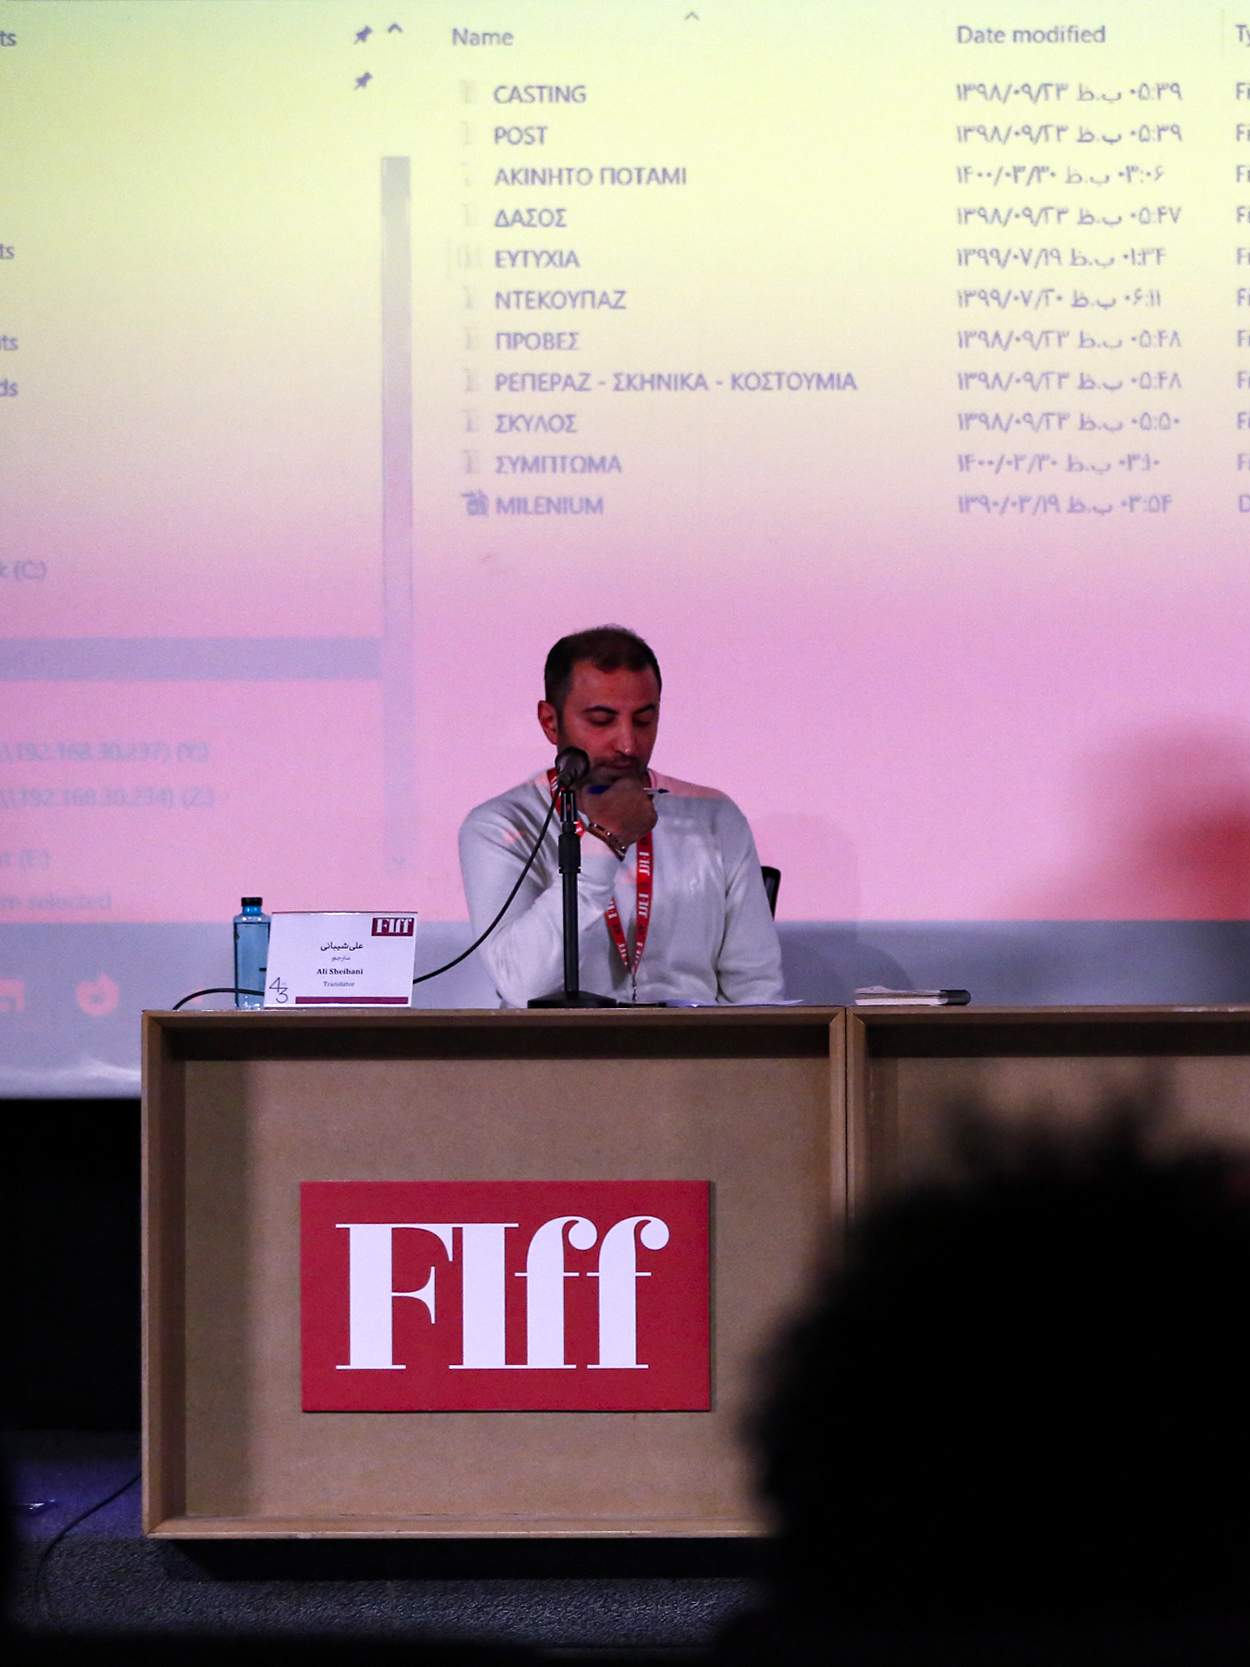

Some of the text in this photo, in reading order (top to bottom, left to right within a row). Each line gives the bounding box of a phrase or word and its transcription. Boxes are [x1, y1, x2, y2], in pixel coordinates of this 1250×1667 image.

[451, 26, 515, 47] Name
[956, 24, 1107, 45] Date modified
[492, 83, 588, 105] CASTING
[492, 124, 549, 147] POST
[494, 166, 688, 187] ΑΚΙΝΗΤΟ ΠΟΤΑΜΙ
[493, 206, 568, 229] ΔΑΣΟΣ
[494, 248, 581, 269] ΕΥΤΥΧΙΑ
[494, 288, 627, 311] ΝΤΕΚΟΥΠΑΖ
[494, 330, 580, 351] ΠΡΟΒΕΣ
[494, 371, 592, 393] ΡΕΠΕΡΑΖ
[612, 371, 710, 393] ΣΚΗΝΙΚΑ
[730, 370, 859, 392] ΚΟΣΤΟΥΜΙΑ
[494, 412, 578, 435] ΣΚΥΛΟΣ
[495, 454, 623, 475] ΣΥΜΠΤΩΜΑ
[495, 495, 605, 516] MILENIUM
[320, 941, 364, 951] علی شیبانی
[335, 1215, 670, 1370] FIff
